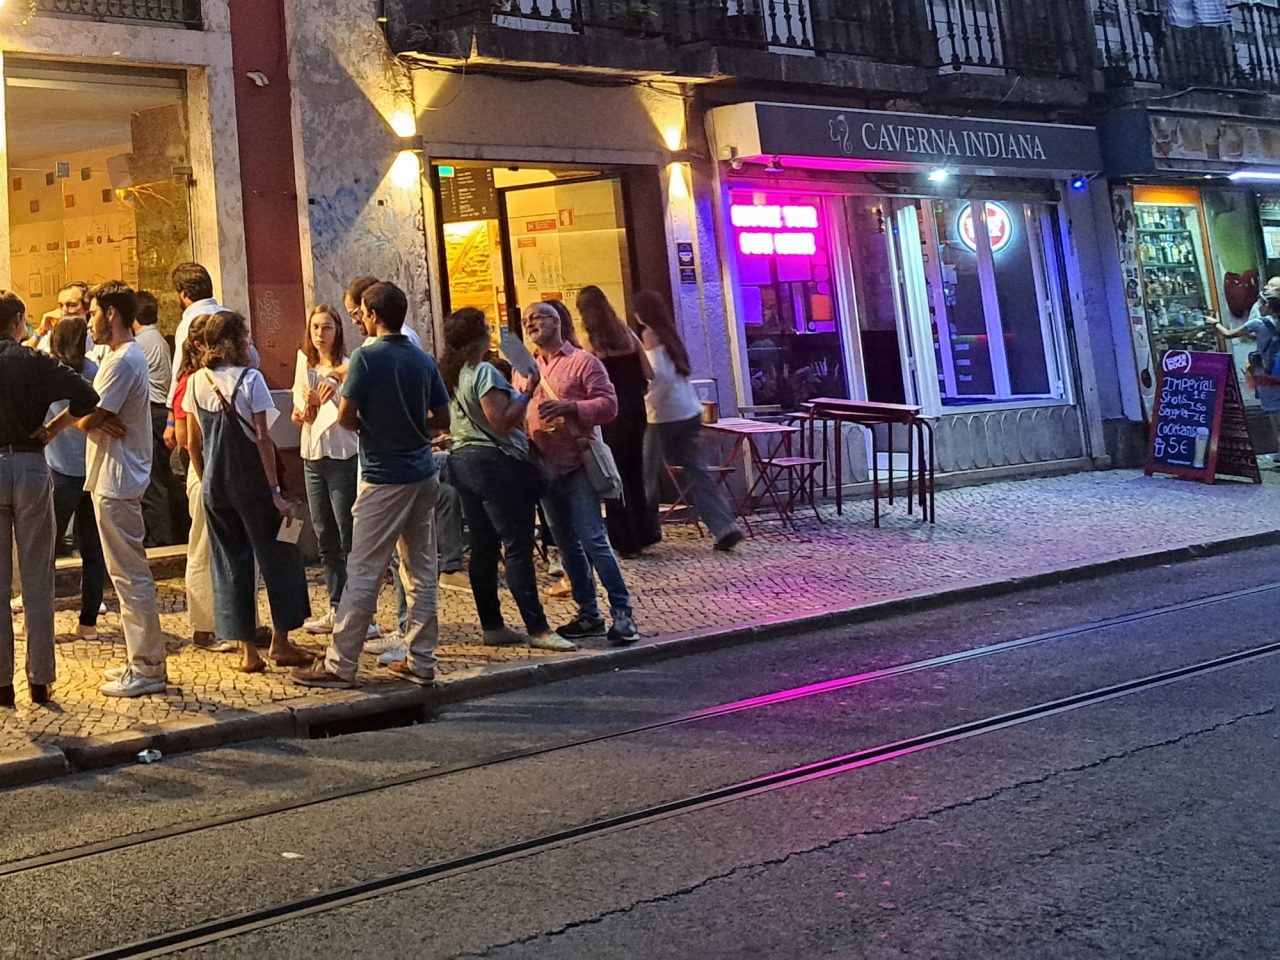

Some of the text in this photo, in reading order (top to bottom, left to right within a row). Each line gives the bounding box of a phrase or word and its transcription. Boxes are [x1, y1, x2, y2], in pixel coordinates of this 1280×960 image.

[861, 122, 1047, 160] CAVERNA INDIANA
[1165, 353, 1186, 364] SUPER
[1167, 437, 1188, 454] 5€
